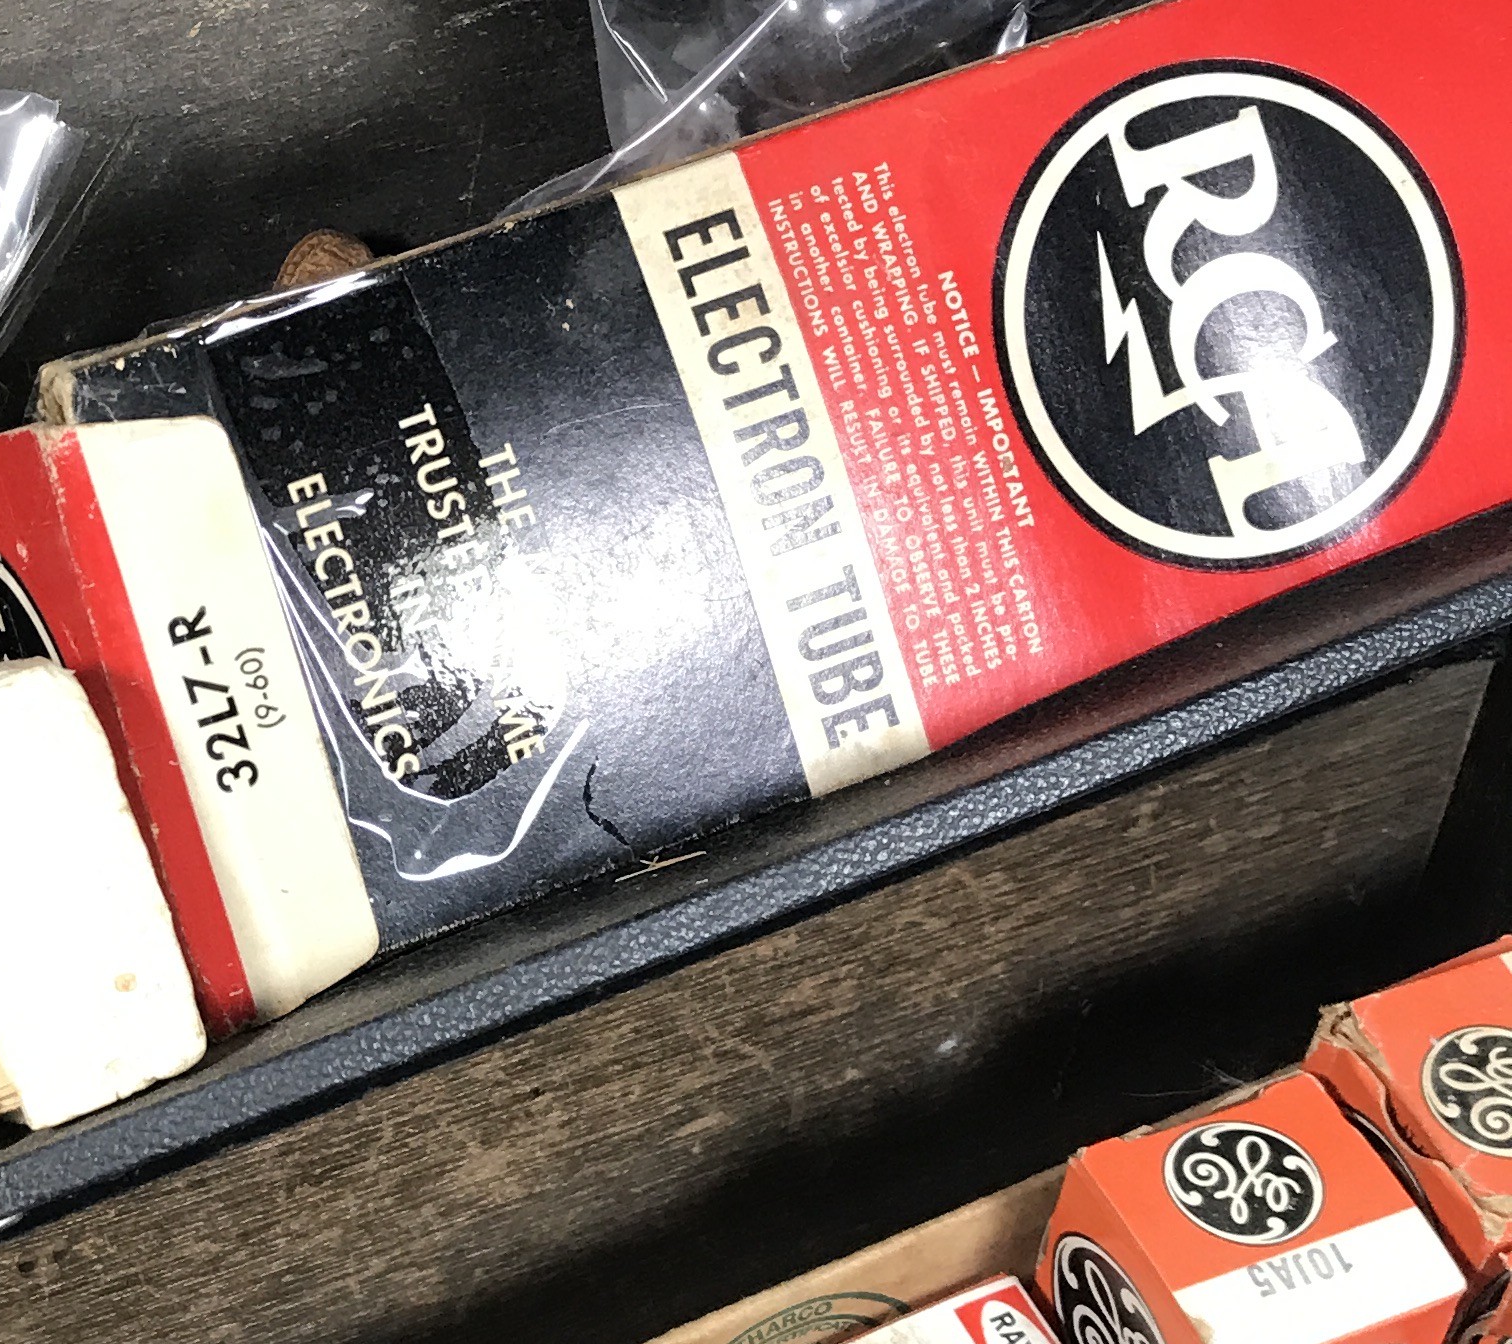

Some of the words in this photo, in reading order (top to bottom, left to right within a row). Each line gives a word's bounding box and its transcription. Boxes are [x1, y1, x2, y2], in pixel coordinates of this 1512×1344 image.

[787, 190, 807, 211] in
[808, 182, 830, 205] of
[829, 175, 863, 233] tected
[851, 168, 880, 215] AND
[872, 161, 898, 200] This
[767, 196, 829, 338] INSTRUCTIONS
[799, 220, 838, 295] another
[818, 209, 860, 293] excelsior
[848, 235, 874, 263] by
[886, 203, 924, 279] electron
[860, 264, 893, 320] being
[914, 282, 941, 326] tube
[848, 297, 897, 399] cushioning
[912, 338, 929, 357] IF
[1109, 105, 1365, 538] RCA
[819, 344, 848, 391] WILL
[882, 322, 930, 428] surrounded
[931, 330, 956, 375] must
[886, 405, 902, 426] or
[918, 363, 959, 448] SHIPPED,
[937, 269, 980, 358] NOTICE
[975, 388, 1035, 529] IMPORTANT
[948, 379, 981, 446] remain
[835, 399, 872, 466] RESULT
[862, 407, 902, 485] FAILURE
[896, 432, 915, 455] its
[915, 432, 939, 458] by
[476, 443, 536, 535] THE
[663, 208, 842, 557] ELECTRON
[785, 564, 901, 750] TUBE
[861, 475, 882, 498] IN
[927, 461, 948, 492] not
[947, 453, 973, 489] this
[969, 450, 1005, 522] WITHIN
[395, 401, 497, 612] TRUSTED
[892, 496, 913, 523] TO
[898, 461, 949, 562] equivalent
[937, 496, 963, 531] less
[961, 495, 986, 533] unit
[870, 507, 913, 594] DAMAGE
[949, 535, 977, 579] than
[974, 539, 1002, 585] must
[993, 526, 1020, 569] THIS
[900, 533, 944, 618] OBSERVE
[935, 567, 960, 604] and
[964, 582, 980, 596] 2
[285, 471, 421, 786] ELECTRONICS
[900, 603, 922, 630] TO
[989, 591, 1012, 616] be
[1006, 573, 1045, 654] CARTON
[929, 628, 962, 685] THESE
[945, 610, 981, 677] packed
[967, 599, 1003, 669] INCHES
[995, 622, 1023, 662] pro-
[232, 643, 287, 731] (9-60)
[909, 639, 939, 687] TUBE
[163, 604, 261, 797] 32L7-R
[1247, 1243, 1354, 1298] 10JA5
